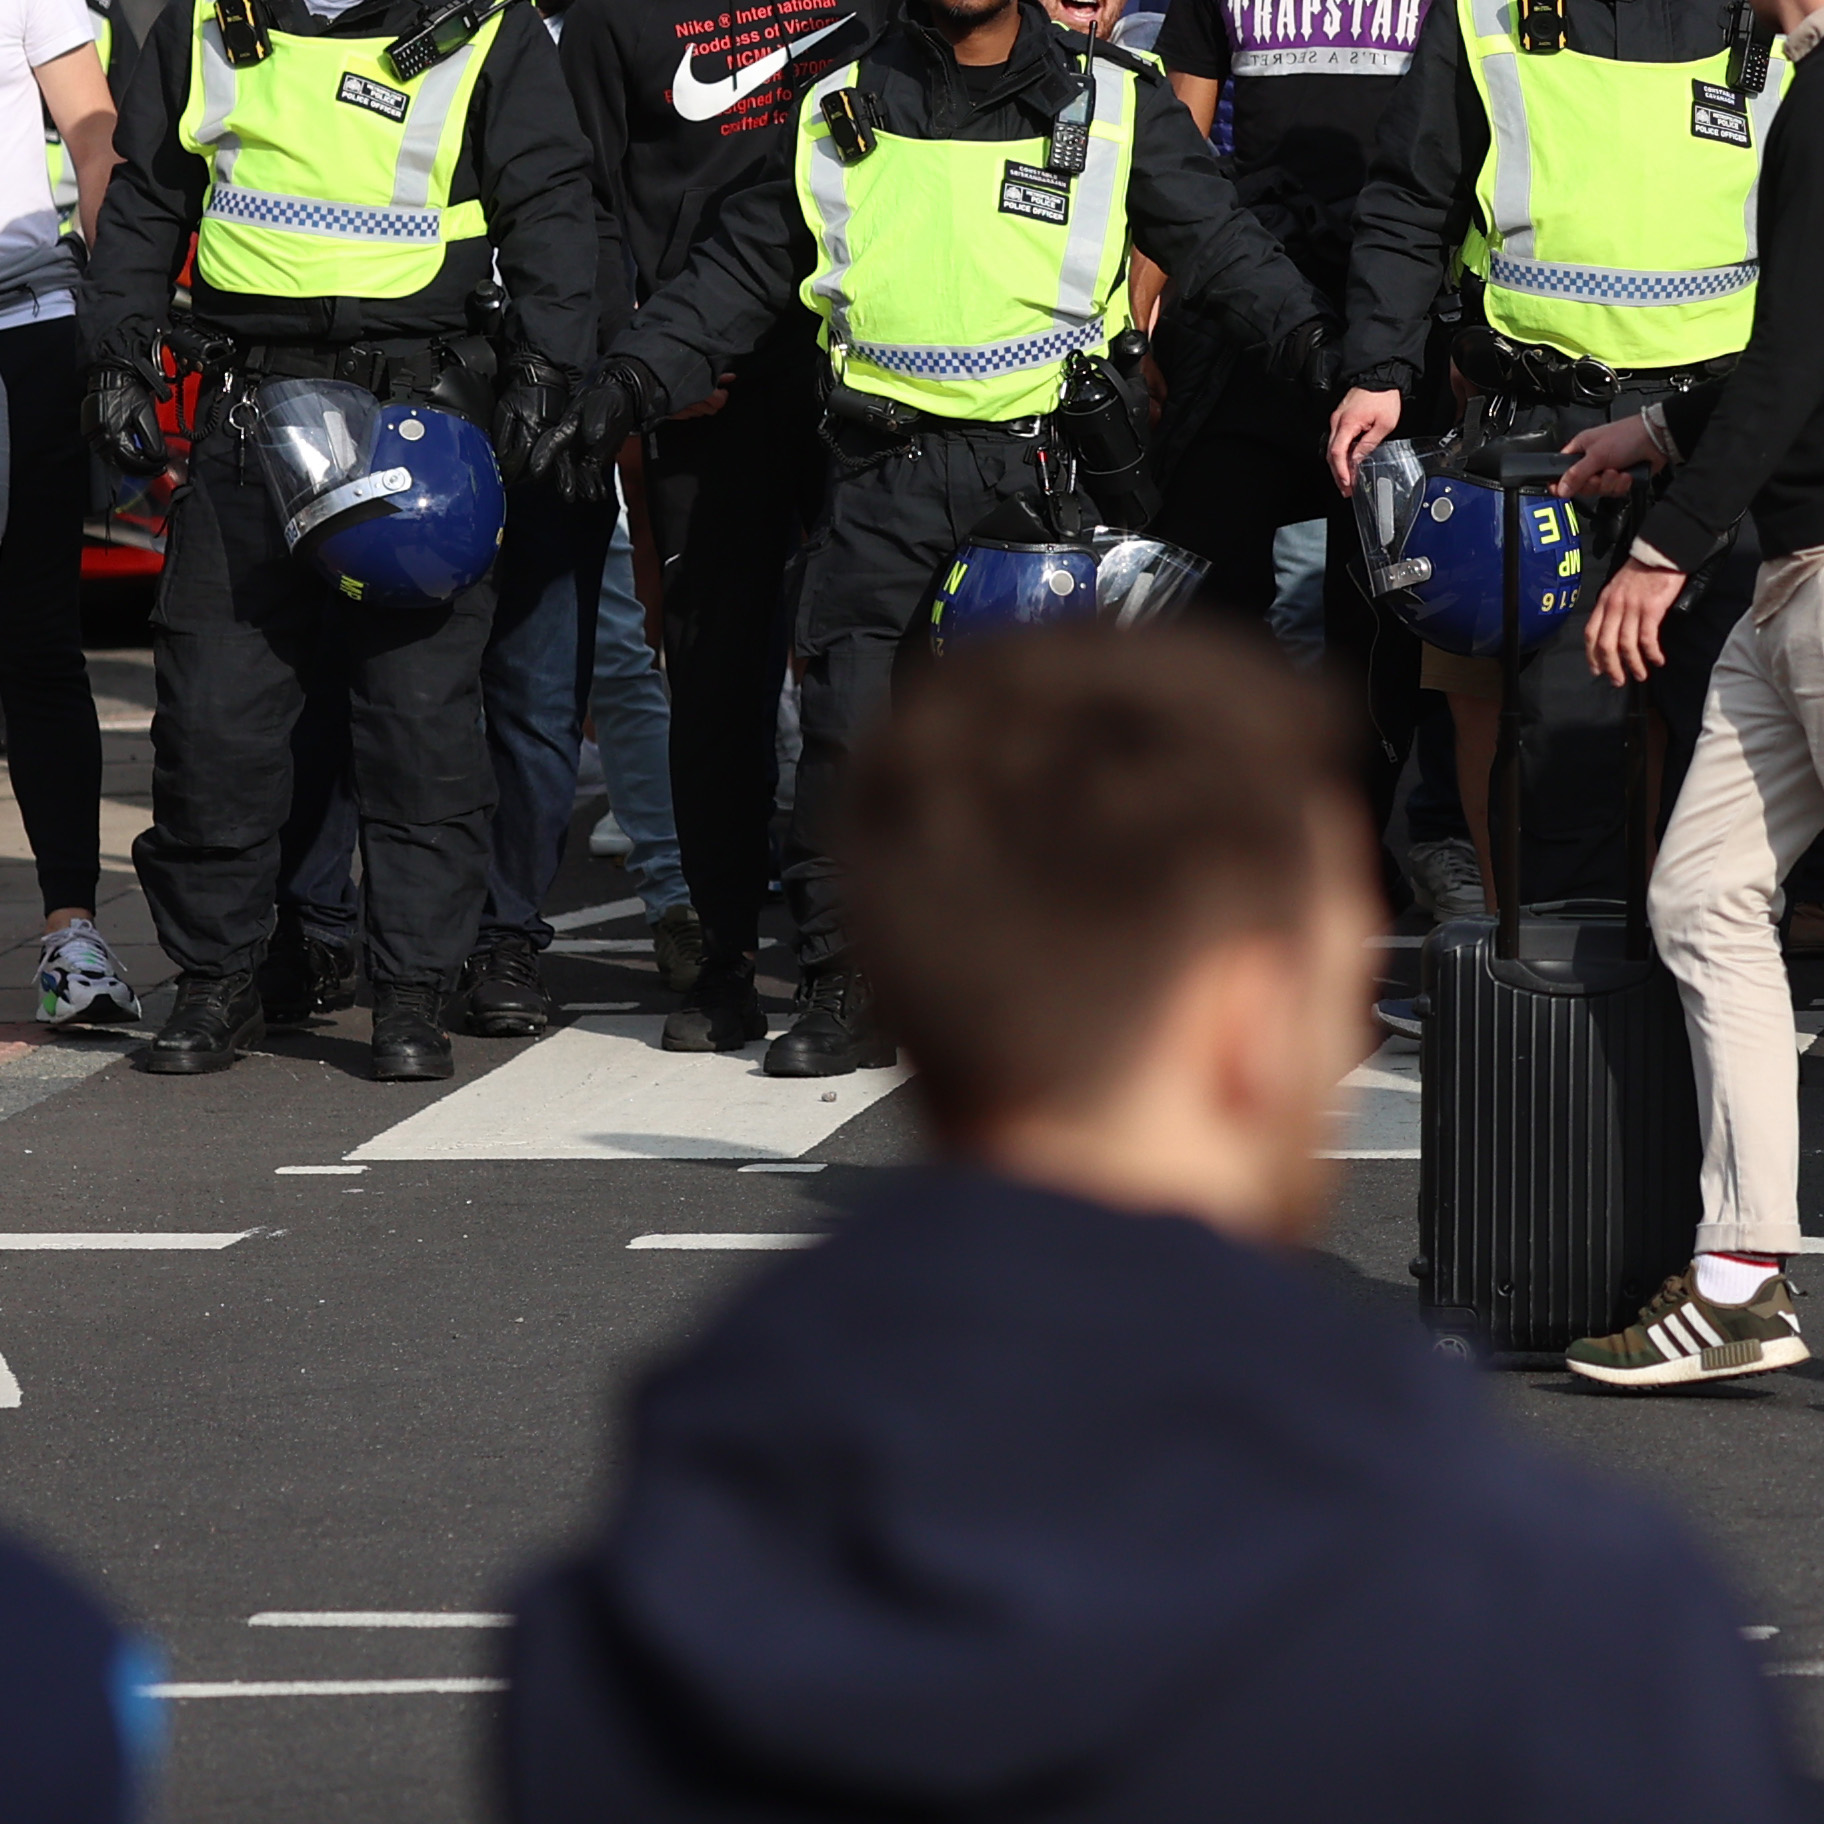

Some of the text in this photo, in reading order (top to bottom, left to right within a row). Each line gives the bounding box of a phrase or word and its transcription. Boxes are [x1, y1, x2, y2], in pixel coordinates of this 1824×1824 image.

[674, 18, 715, 39] Nike
[764, 24, 781, 42] of
[341, 90, 402, 118] POLICE OFFICER
[1694, 124, 1748, 144] POLICE OFFICER
[1003, 201, 1065, 221] POLICE OFFICER
[1030, 196, 1056, 209] POLICE
